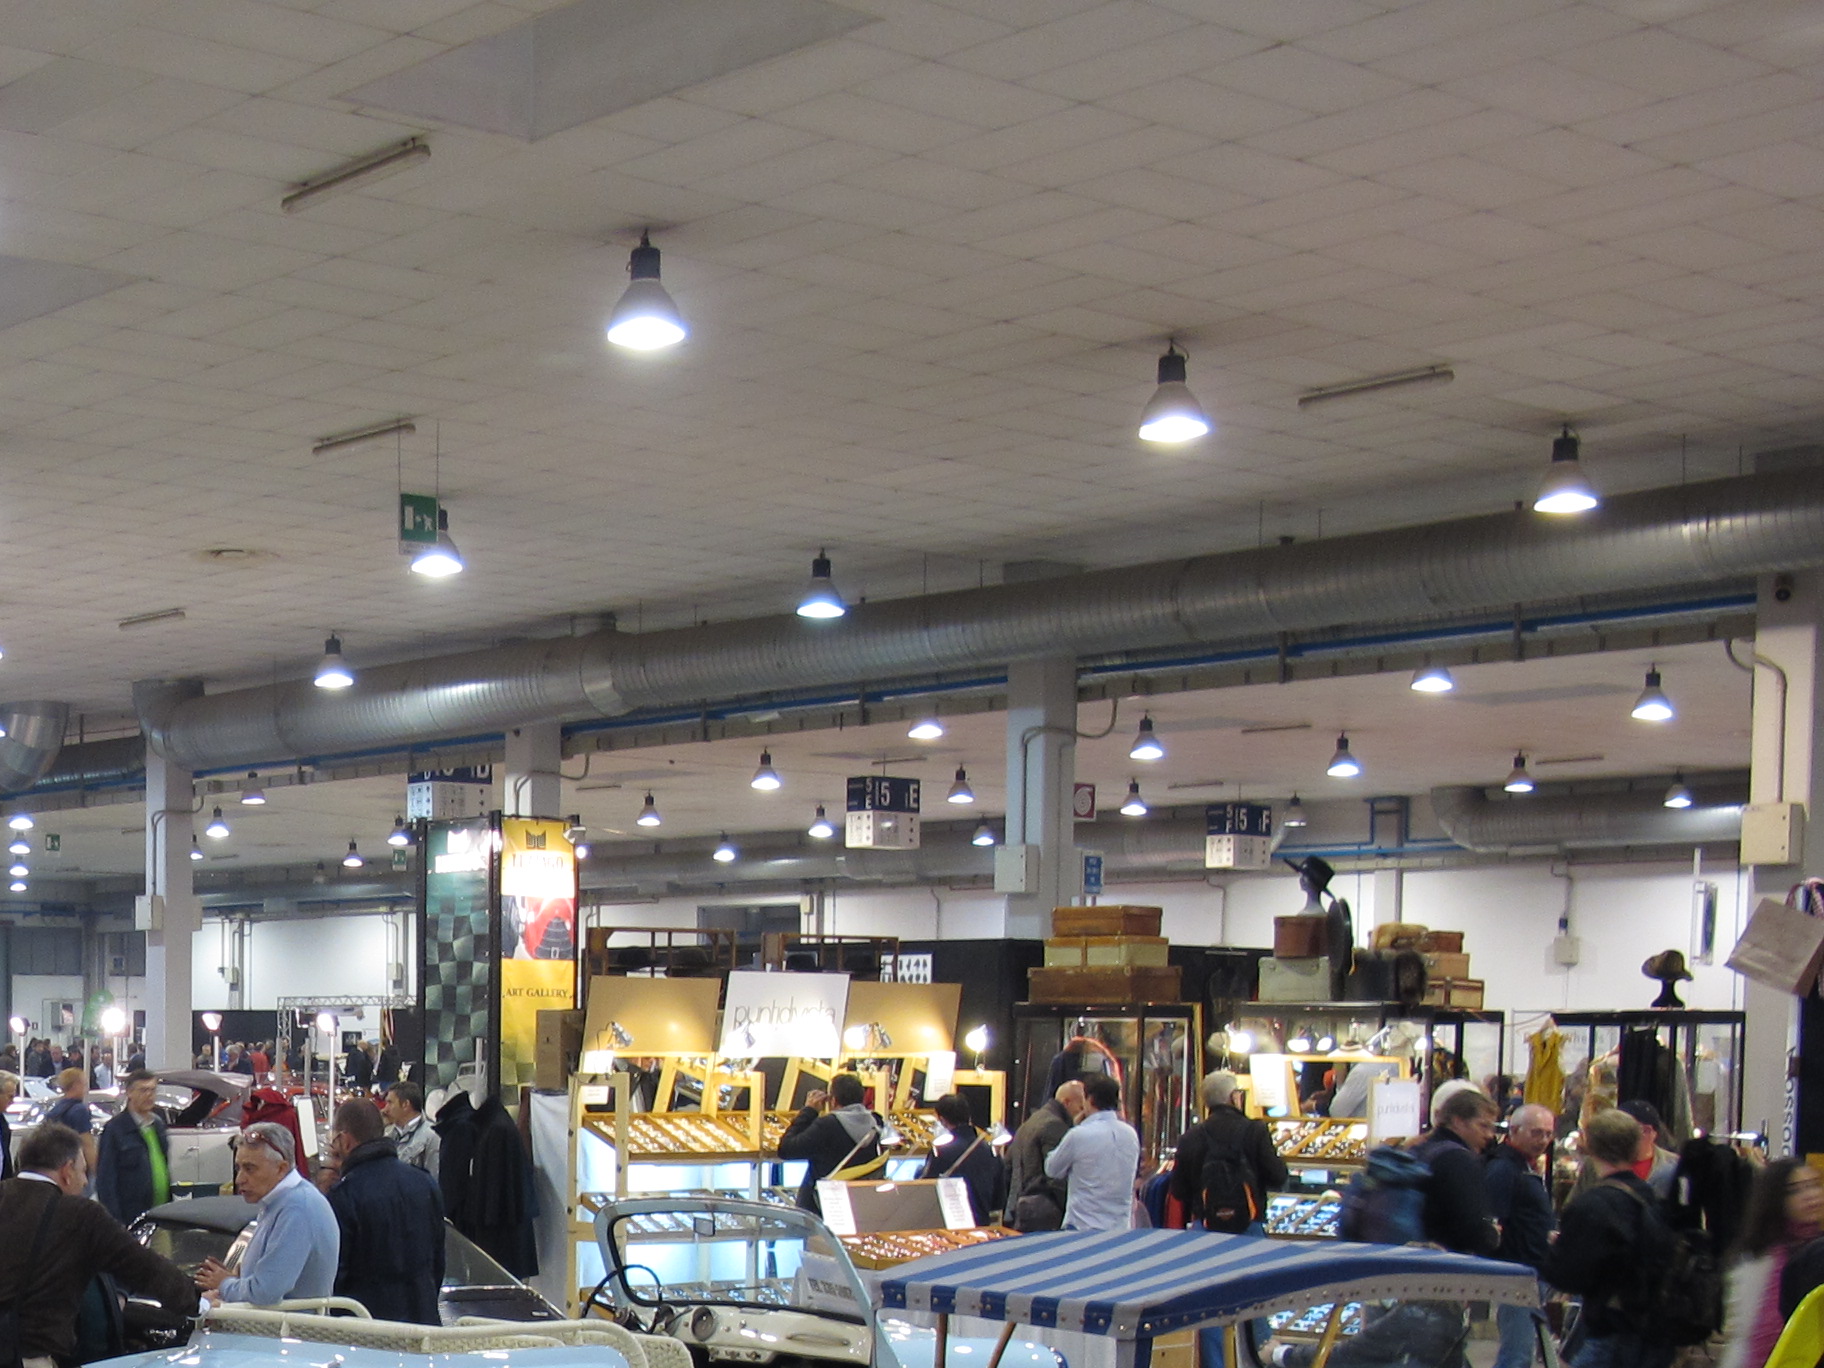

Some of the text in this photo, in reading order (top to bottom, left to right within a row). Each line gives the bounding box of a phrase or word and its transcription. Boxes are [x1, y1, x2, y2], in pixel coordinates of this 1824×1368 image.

[880, 781, 920, 808] 5 E
[1238, 807, 1272, 833] 5 F
[506, 987, 568, 999] ART GALLERY
